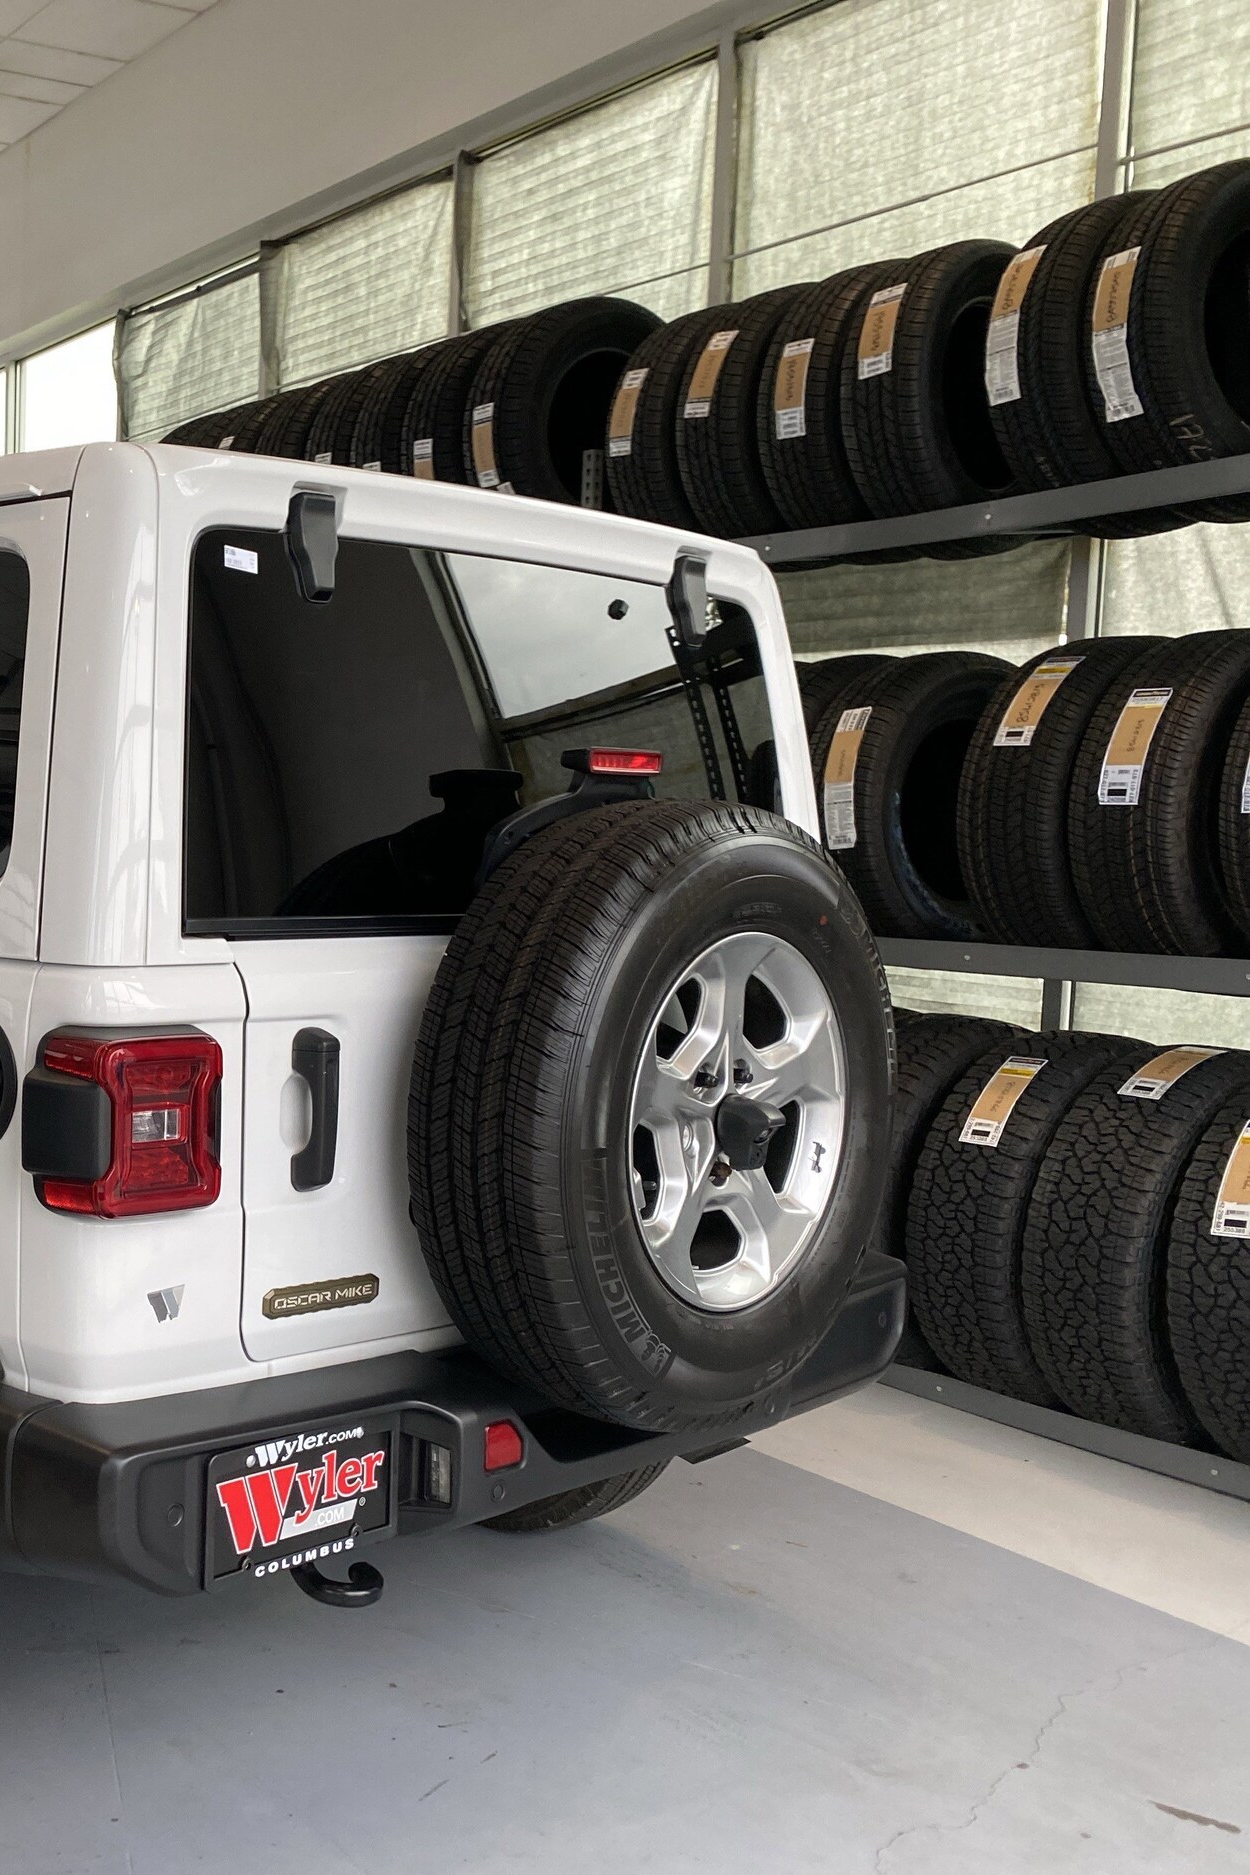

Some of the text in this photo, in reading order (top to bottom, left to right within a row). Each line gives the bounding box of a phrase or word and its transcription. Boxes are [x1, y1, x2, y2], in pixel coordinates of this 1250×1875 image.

[581, 1160, 646, 1344] MICHELIN
[274, 1284, 372, 1309] OSCAR MIKE
[216, 1450, 385, 1554] Wyler
[314, 1506, 345, 1527] .COM
[255, 1538, 354, 1578] COLUMBUS
